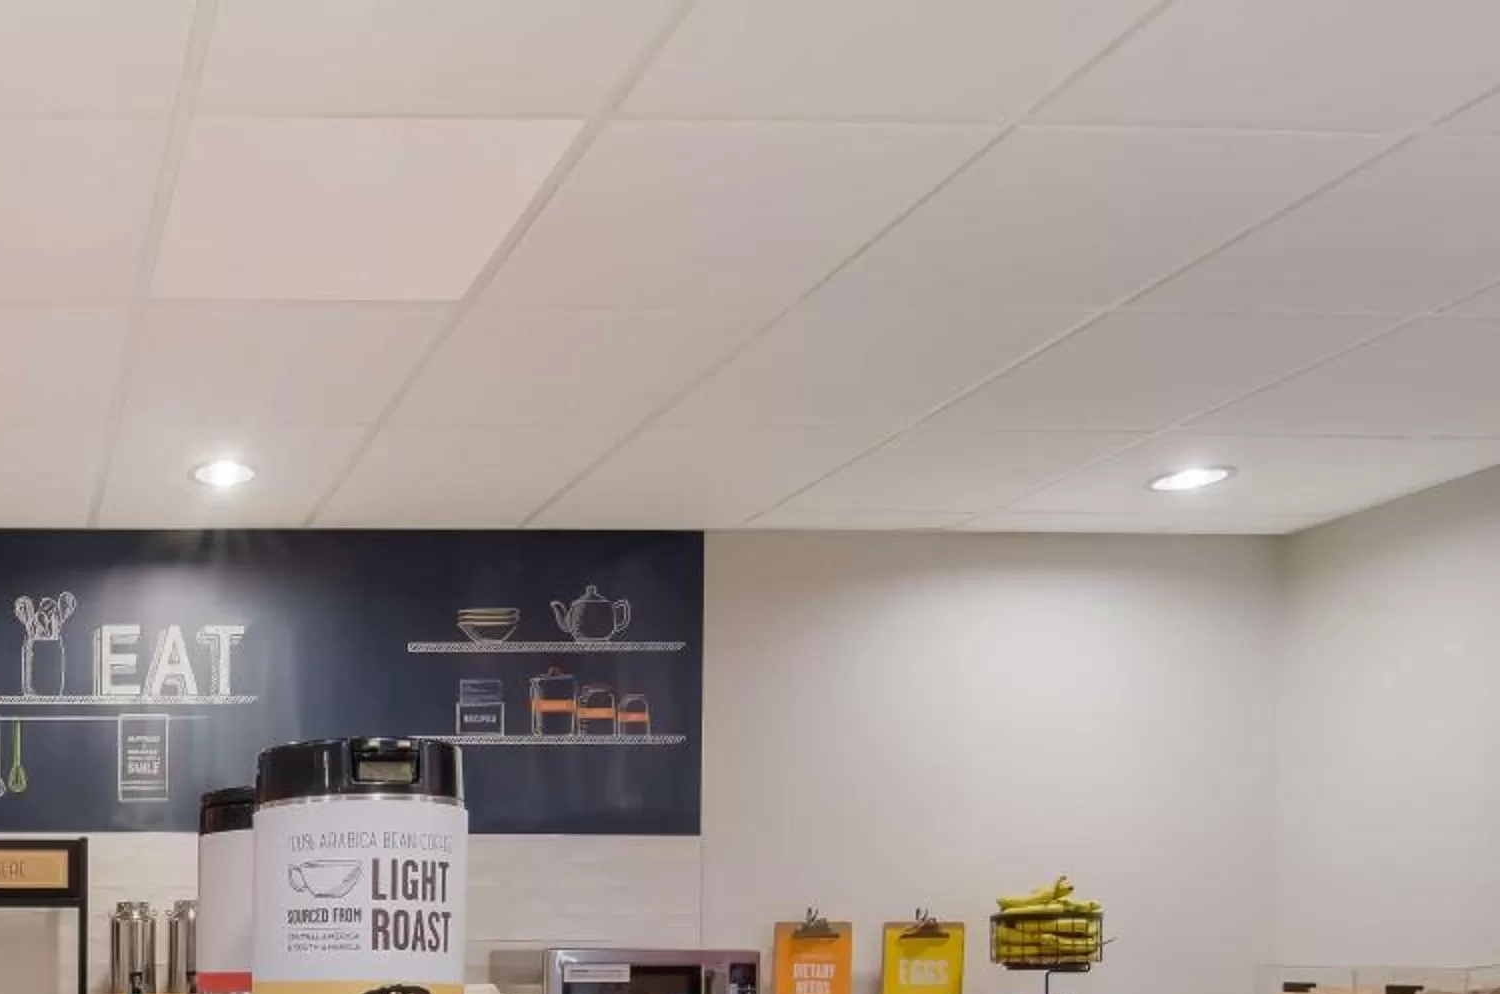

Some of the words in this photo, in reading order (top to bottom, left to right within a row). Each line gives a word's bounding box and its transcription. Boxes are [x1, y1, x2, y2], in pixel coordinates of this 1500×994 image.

[92, 623, 245, 697] EAT
[383, 831, 417, 849] BEAN
[371, 857, 450, 904] LIGHT
[287, 907, 329, 924] SOURCED
[332, 906, 363, 924] FROM
[371, 908, 452, 953] ROAST
[899, 959, 949, 985] EGGS
